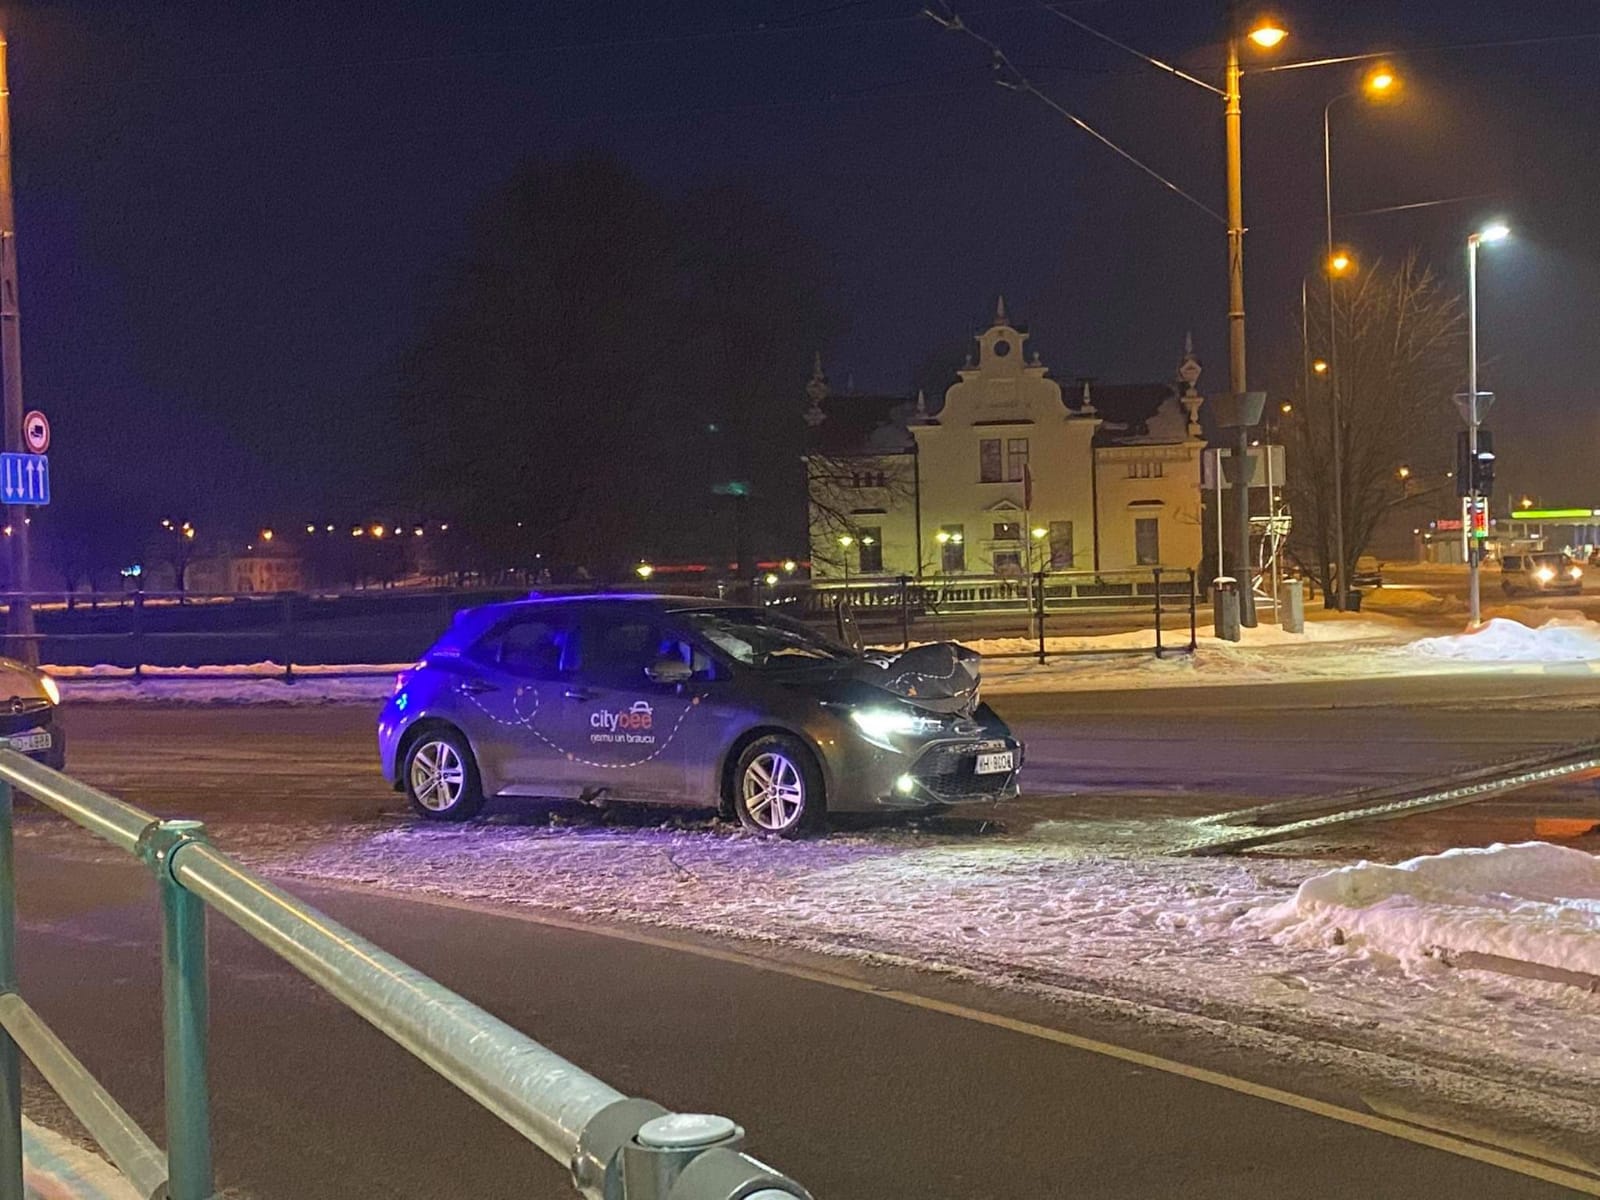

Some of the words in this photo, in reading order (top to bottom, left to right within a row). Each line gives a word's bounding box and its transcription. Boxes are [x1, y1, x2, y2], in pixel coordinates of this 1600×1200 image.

[590, 709, 652, 732] citybee
[615, 734, 625, 743] un
[626, 733, 655, 743] braucu
